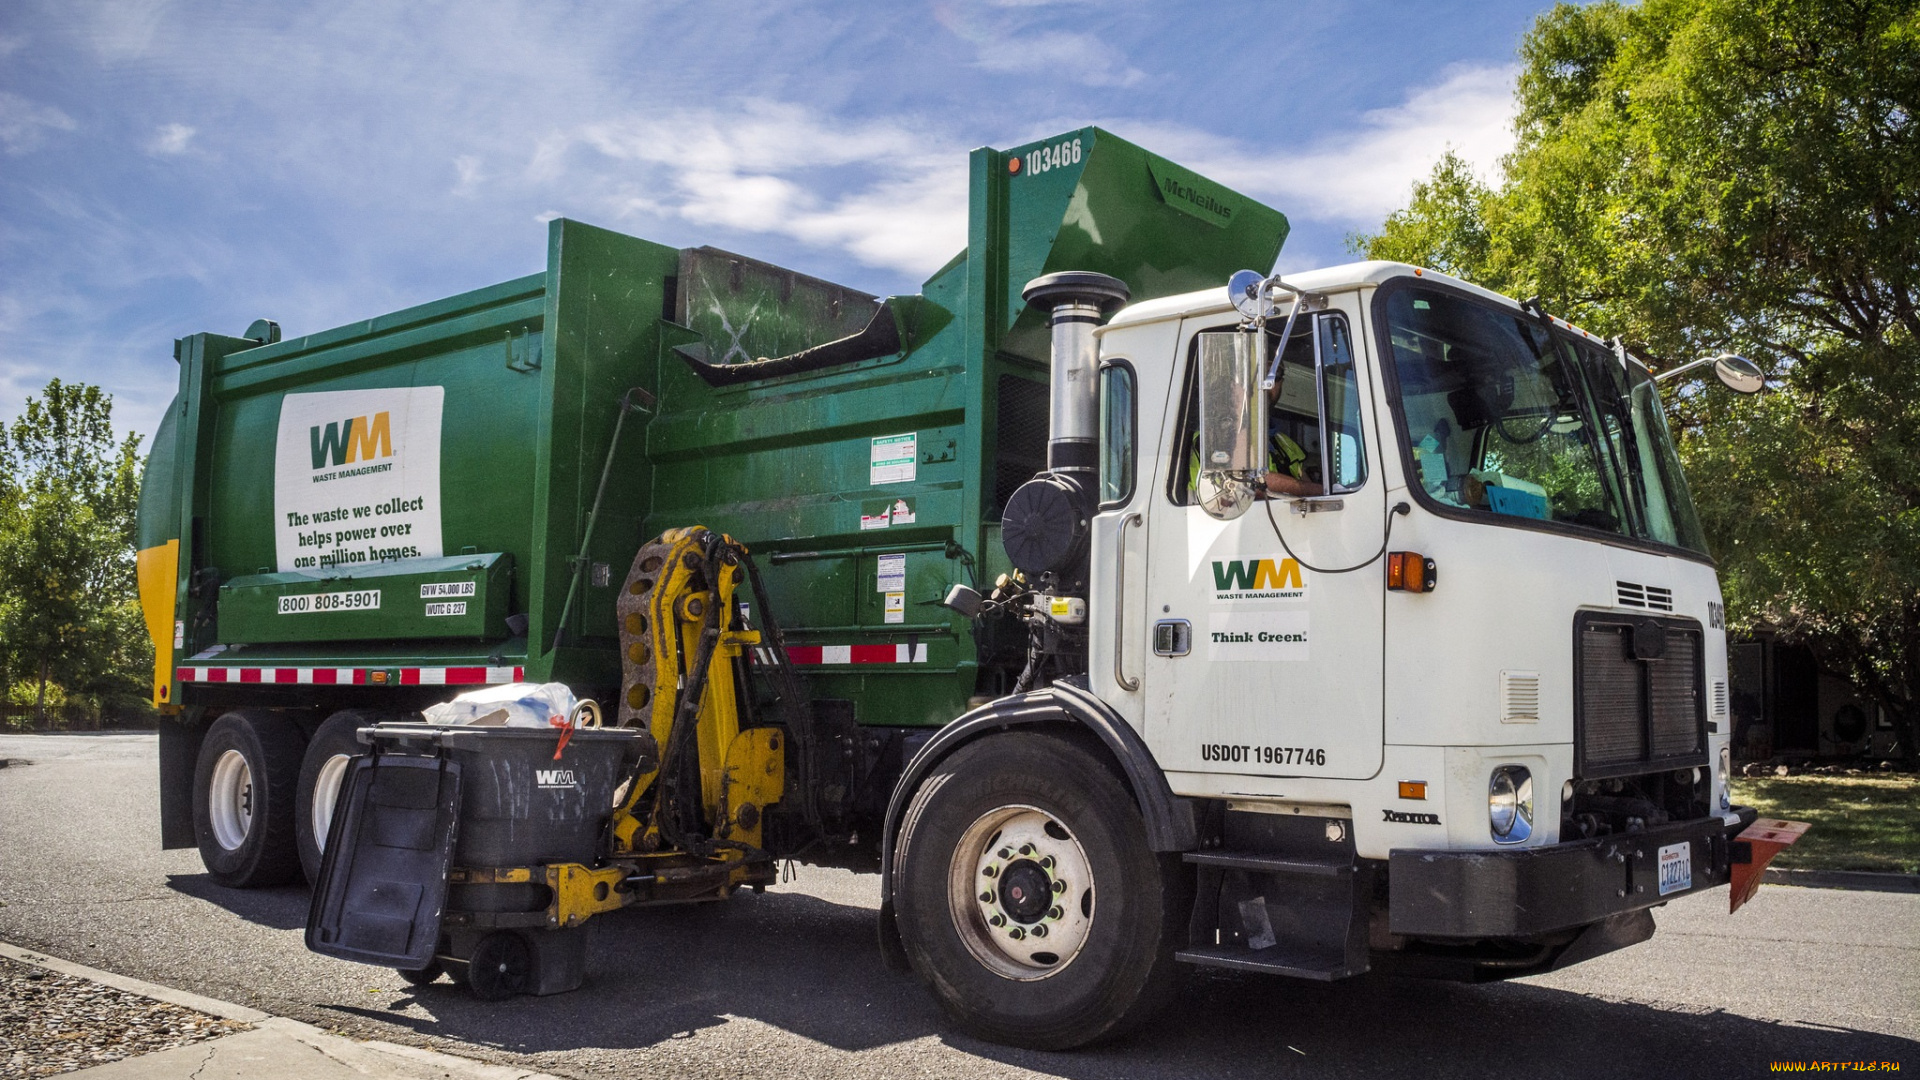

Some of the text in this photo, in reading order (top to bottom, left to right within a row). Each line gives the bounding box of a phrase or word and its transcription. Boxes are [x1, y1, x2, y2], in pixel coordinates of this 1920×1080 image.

[1025, 138, 1082, 177] 103466
[1164, 178, 1231, 218] McNeilus
[310, 411, 393, 470] WM
[312, 463, 393, 483] WASTE MANAGEMENT
[287, 496, 423, 527] The waste we collect
[298, 522, 412, 549] helps power over
[294, 544, 422, 568] one million homes.
[1212, 558, 1303, 591] WM
[421, 583, 474, 596] GVW 54,000 LBS
[278, 592, 379, 612] (800) 808-5901
[427, 603, 465, 615] WUTC G 237
[1211, 632, 1253, 643] Think
[1201, 744, 1326, 766] USDOT 1967746
[535, 769, 575, 785] WM
